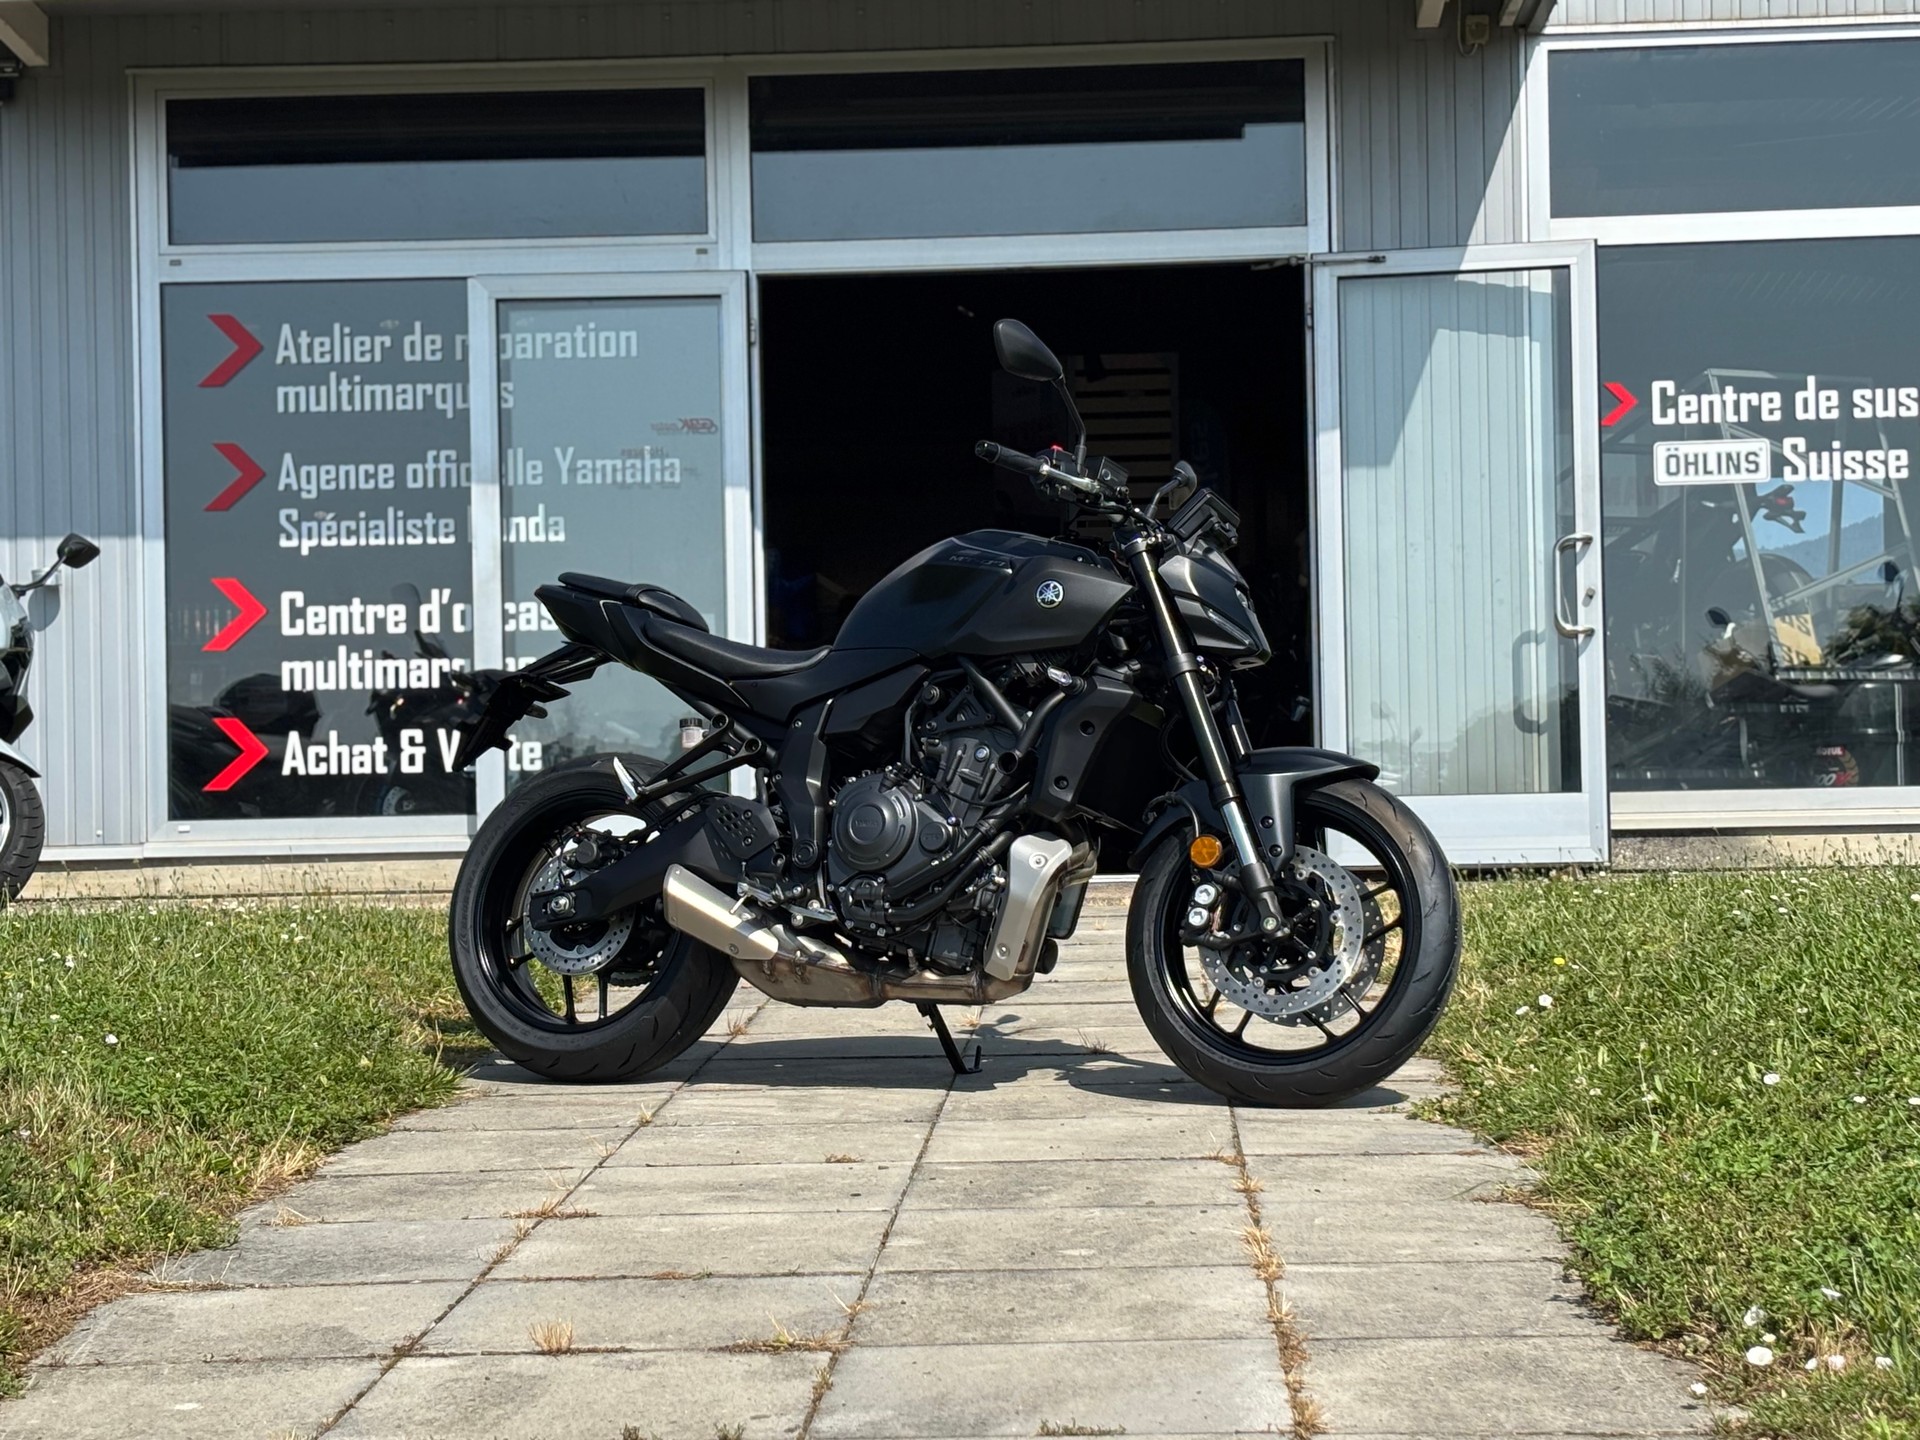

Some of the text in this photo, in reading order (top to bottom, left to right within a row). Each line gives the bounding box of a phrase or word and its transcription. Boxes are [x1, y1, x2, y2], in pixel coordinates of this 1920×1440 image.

[276, 321, 639, 365] Atelier de rparation
[276, 371, 514, 419] multimarqus
[1651, 380, 1782, 425] Centre
[1795, 375, 1840, 421] de
[278, 445, 681, 499] Agence officlle Yamaha
[1665, 437, 1909, 482] ÖHLINS Suisse
[279, 503, 566, 556] Spécialiste nda
[280, 590, 407, 636] Centre
[281, 727, 543, 777] Achat & Vte
